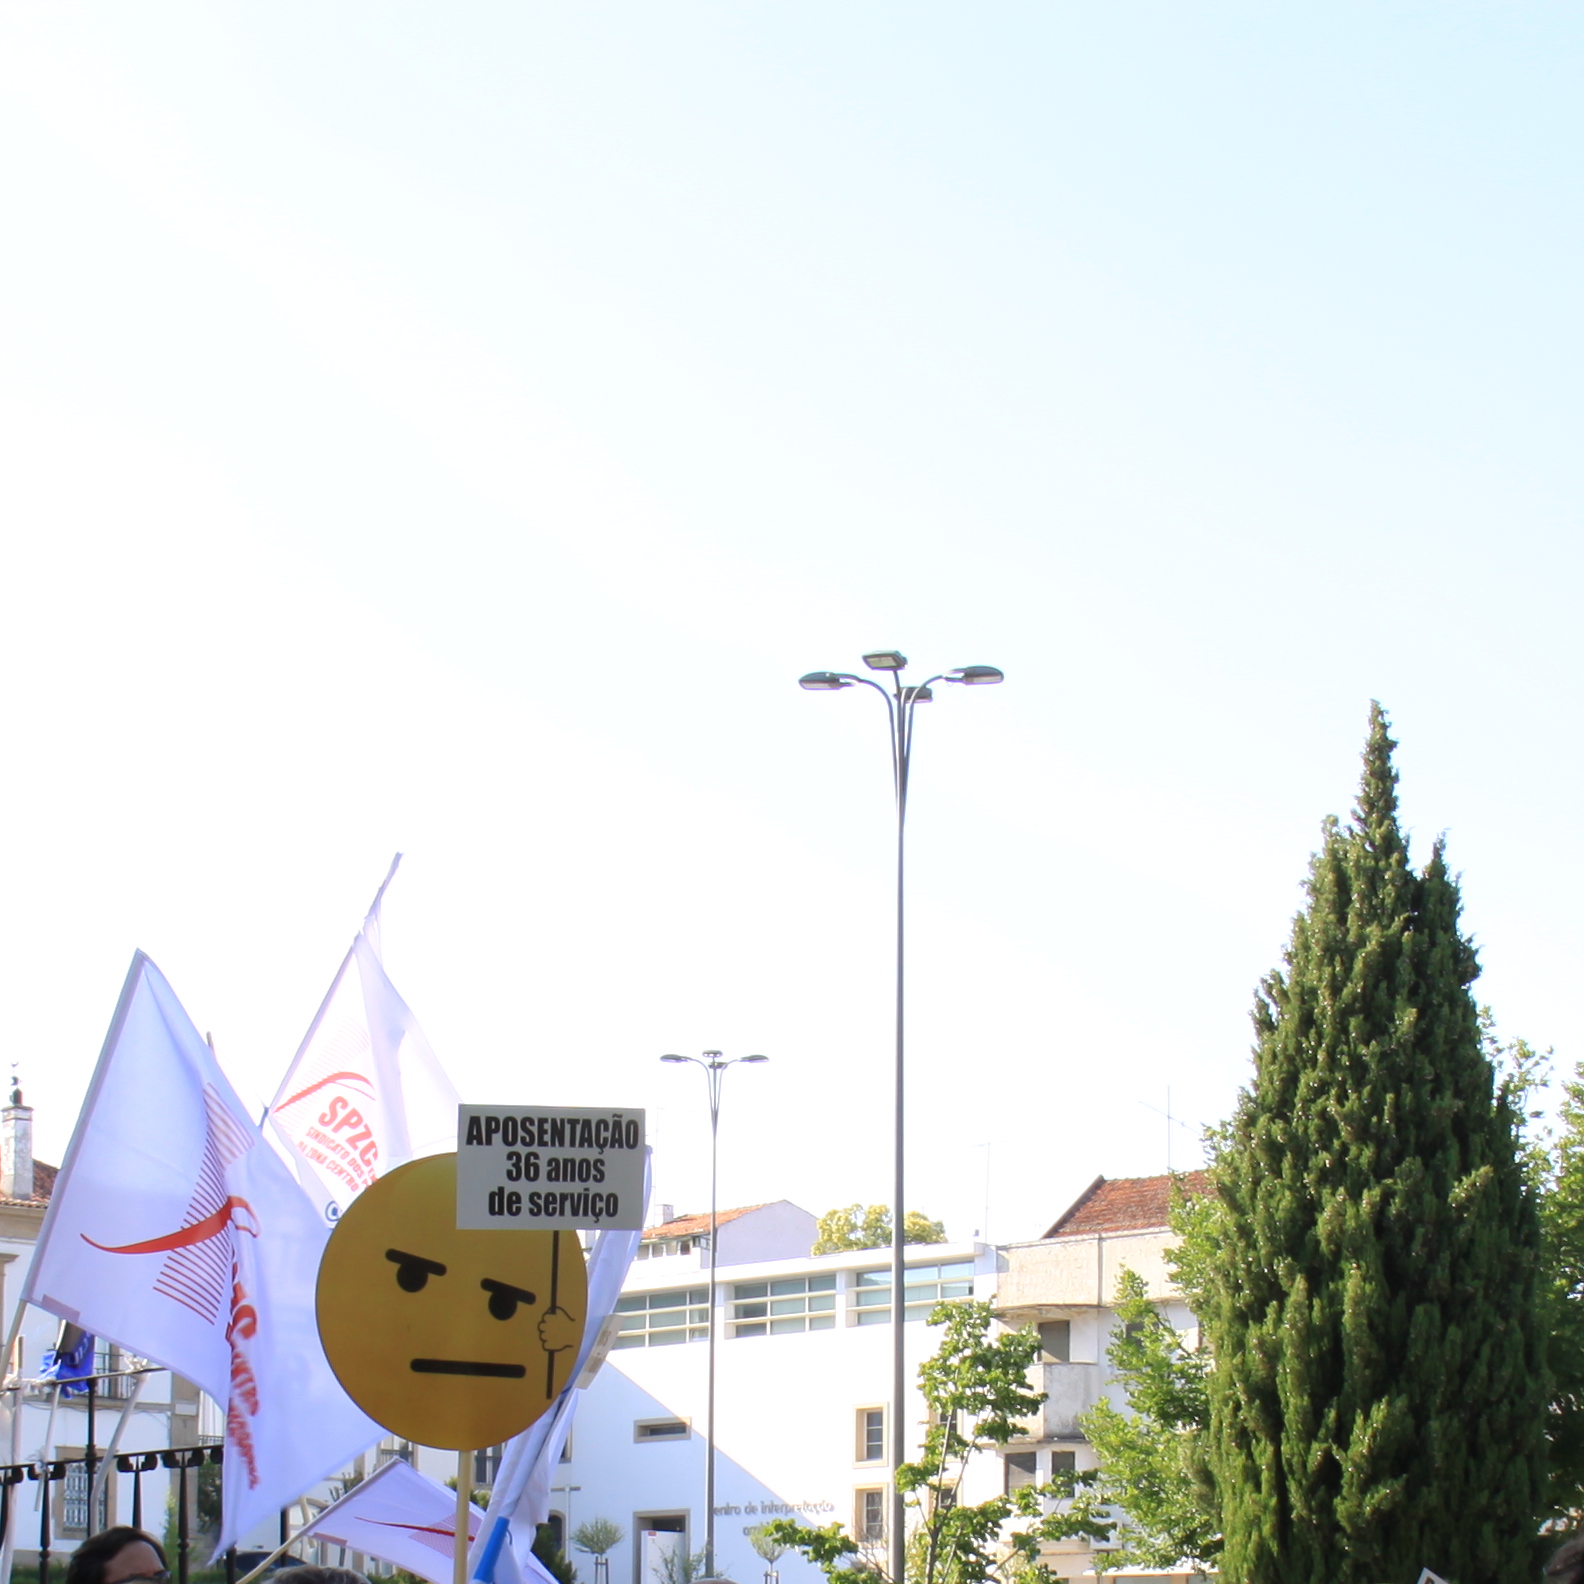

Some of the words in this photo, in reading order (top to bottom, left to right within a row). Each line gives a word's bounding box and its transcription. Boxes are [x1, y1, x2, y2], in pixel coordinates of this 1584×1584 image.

[466, 1113, 638, 1154] APOSENTAÇÃO
[506, 1151, 540, 1182] 36
[547, 1157, 605, 1183] anos
[489, 1186, 521, 1216] de
[529, 1188, 619, 1224] serviço
[744, 1501, 759, 1516] de
